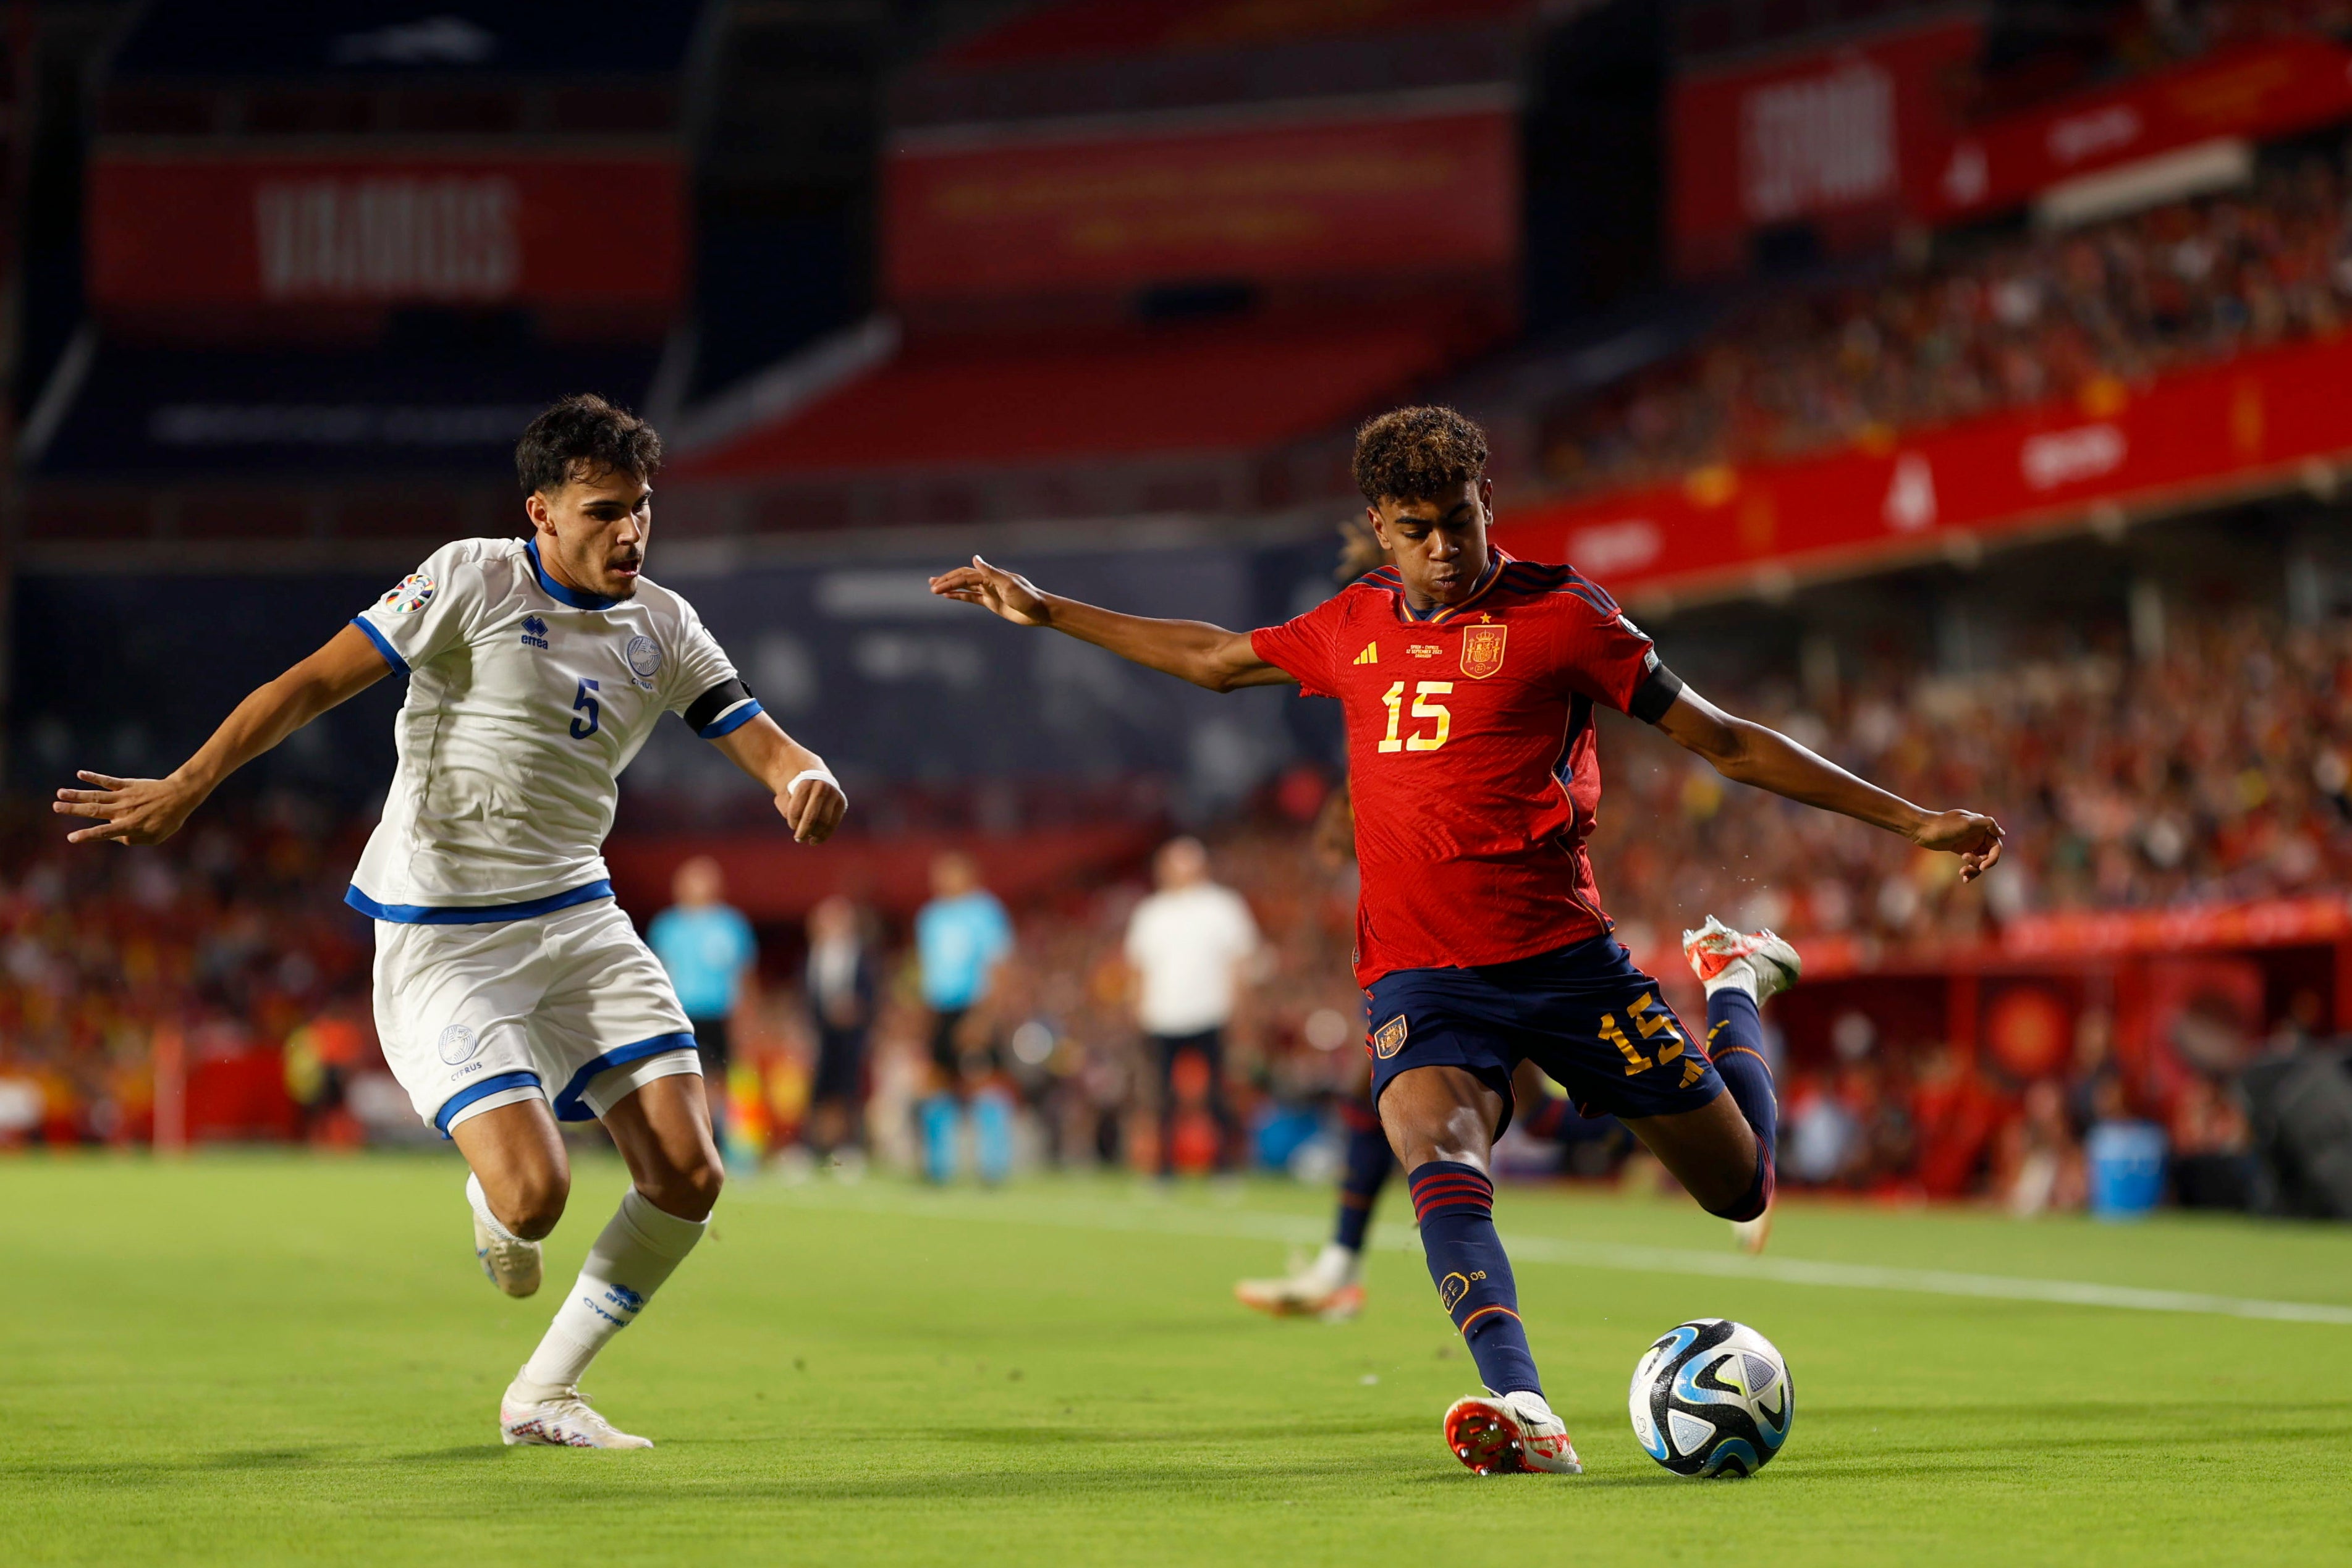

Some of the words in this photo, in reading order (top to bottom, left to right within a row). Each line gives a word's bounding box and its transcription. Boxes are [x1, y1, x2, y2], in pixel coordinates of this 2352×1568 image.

[570, 677, 599, 740] 5
[632, 678, 653, 689] CYRUS
[1378, 681, 1453, 753] 15
[1598, 991, 1685, 1076] 15
[1470, 1270, 1487, 1281] 09
